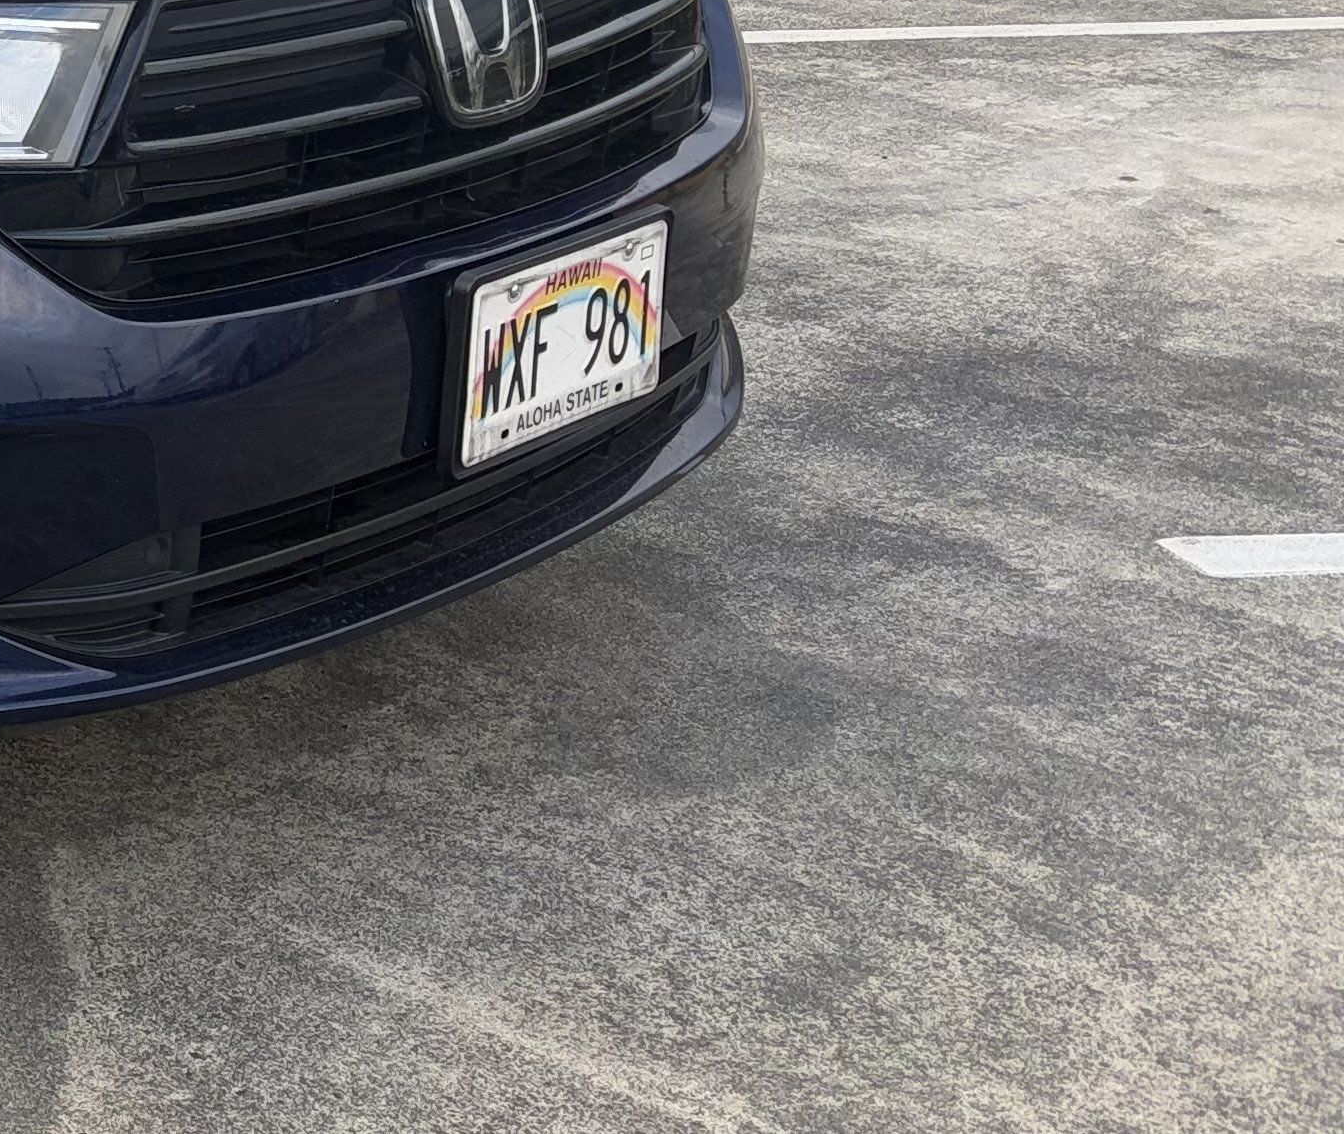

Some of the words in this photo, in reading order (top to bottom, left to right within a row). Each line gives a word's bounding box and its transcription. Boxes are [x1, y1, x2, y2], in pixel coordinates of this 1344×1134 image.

[544, 257, 603, 296] HAWAII
[480, 303, 558, 419] WXF
[583, 269, 650, 377] 981
[515, 398, 562, 433] ALOHA
[565, 380, 609, 412] STATE
